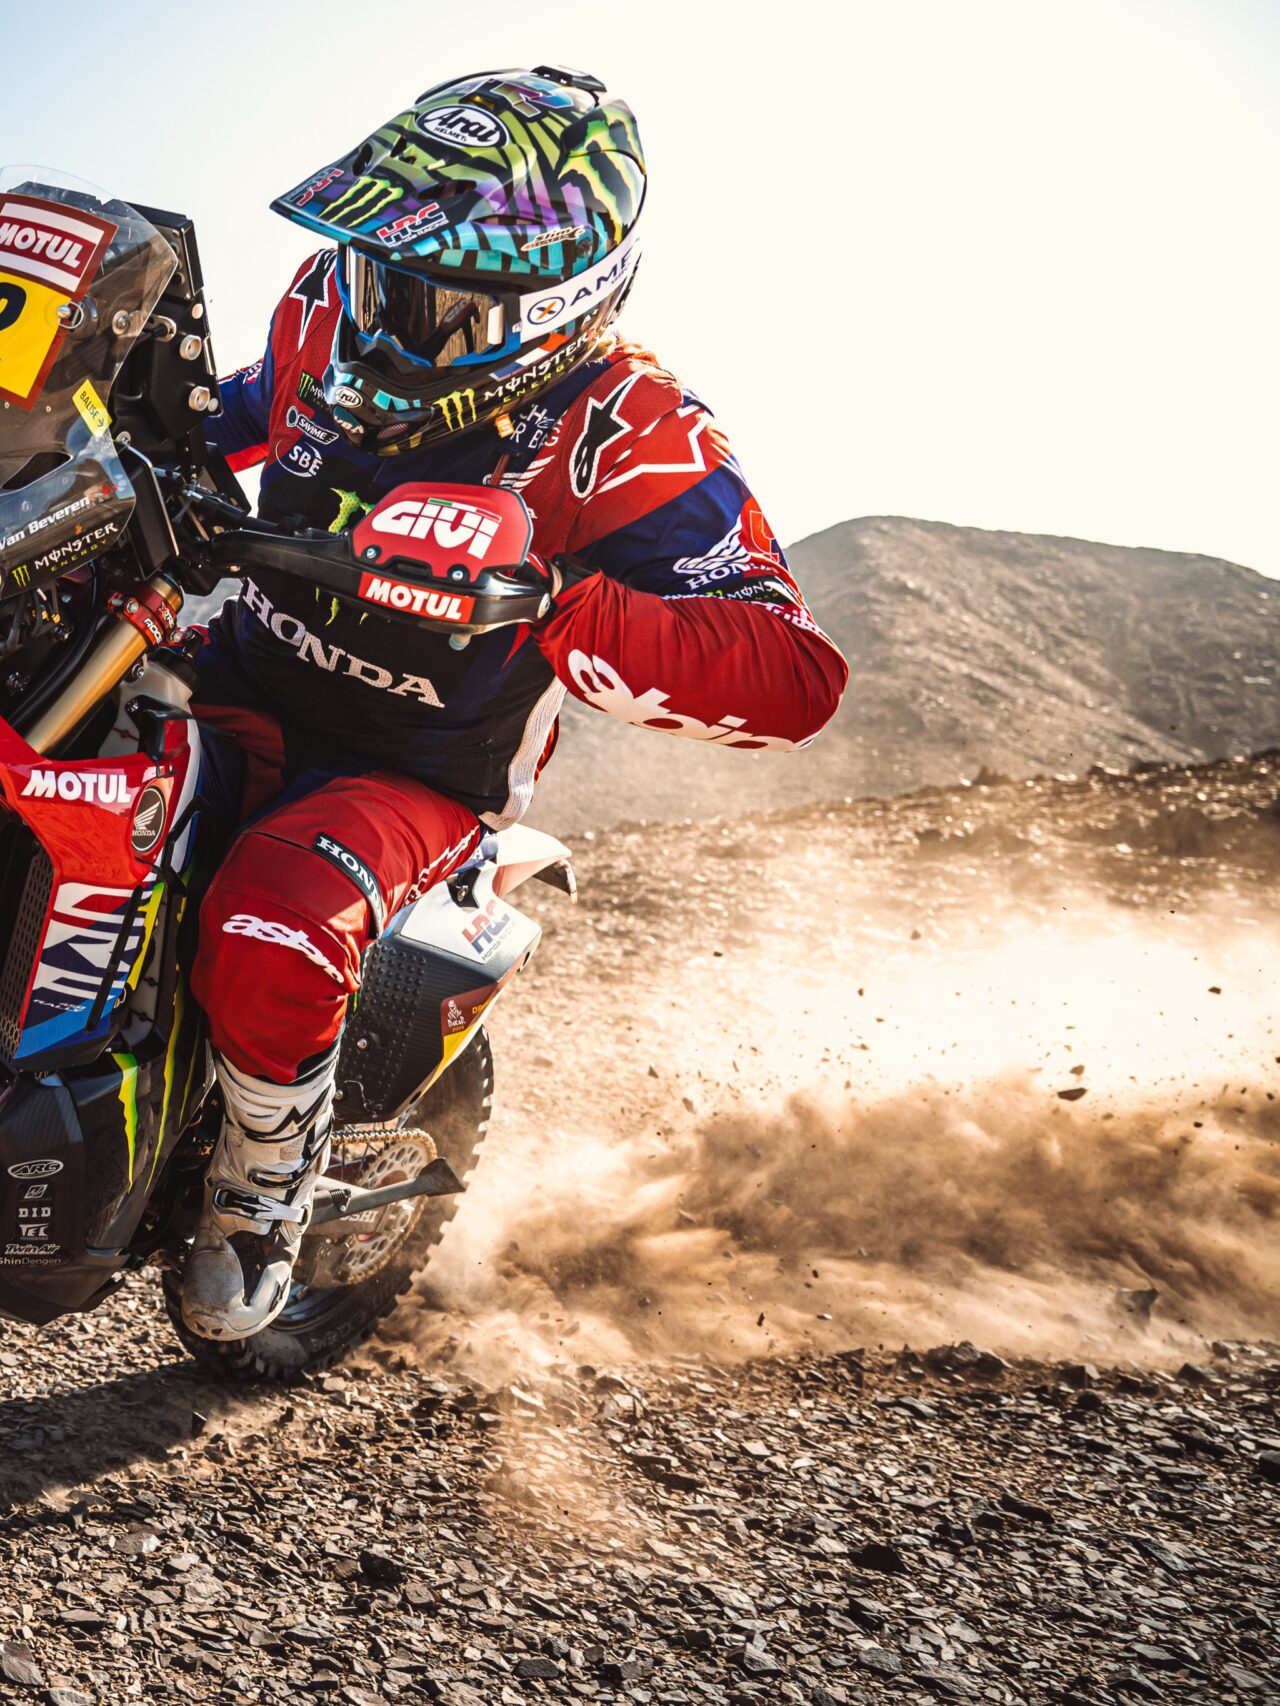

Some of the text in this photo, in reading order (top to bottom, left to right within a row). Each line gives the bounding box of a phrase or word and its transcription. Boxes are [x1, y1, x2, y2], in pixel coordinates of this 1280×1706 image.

[424, 109, 499, 142] Arai
[376, 202, 446, 246] HRC
[503, 357, 575, 403] ENERGY
[80, 390, 99, 420] BALISE
[288, 445, 322, 476] SBE
[27, 496, 90, 535] Beveren
[372, 500, 501, 560] GIVI
[33, 522, 119, 570] MONSTER
[50, 539, 108, 573] ENERGY
[365, 578, 463, 620] MOTUL
[239, 576, 446, 709] HONDA
[21, 770, 131, 804] MOTUL
[131, 829, 156, 837] HONDA
[461, 899, 511, 955] HRC
